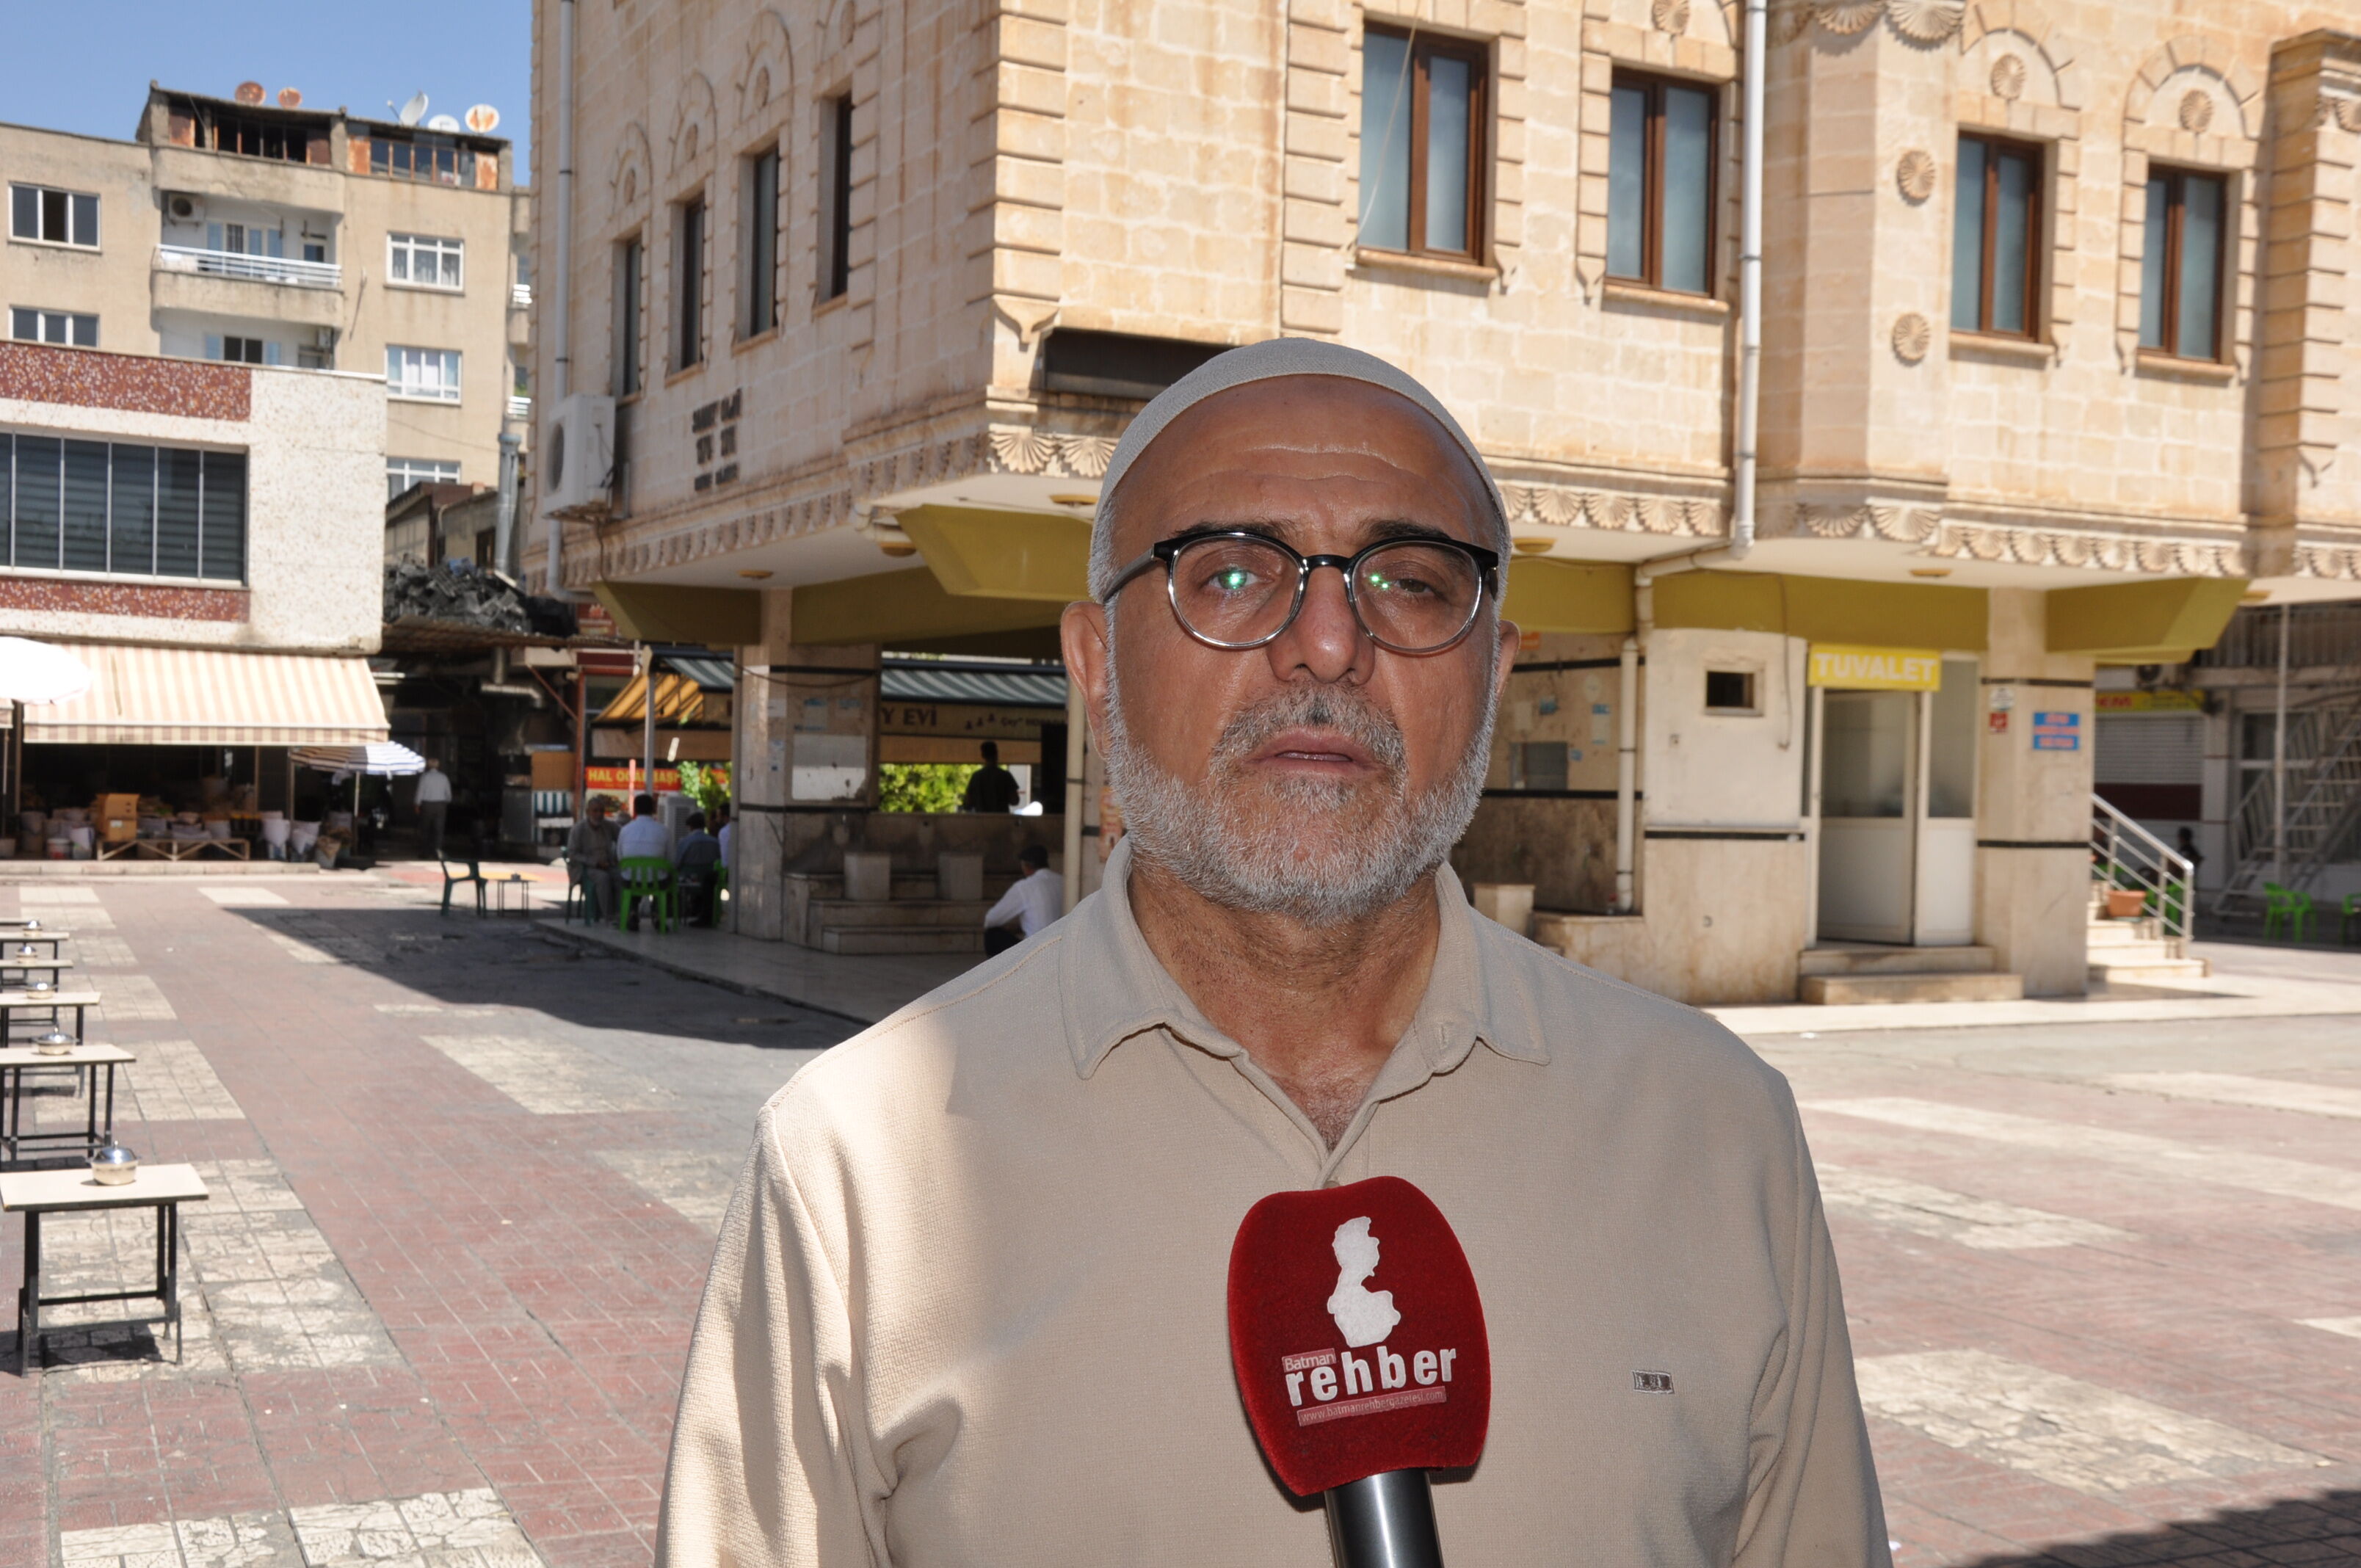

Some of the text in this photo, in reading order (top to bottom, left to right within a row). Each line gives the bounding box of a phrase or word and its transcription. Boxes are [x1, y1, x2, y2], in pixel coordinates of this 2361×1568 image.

[1814, 653, 1937, 682] TUVALET
[904, 705, 937, 726] EVİ
[588, 769, 613, 782] HAL
[1285, 1352, 1335, 1372] Batman
[1285, 1345, 1457, 1407] rehber
[1301, 1390, 1444, 1423] www.batmanrehbergazetesi.com
